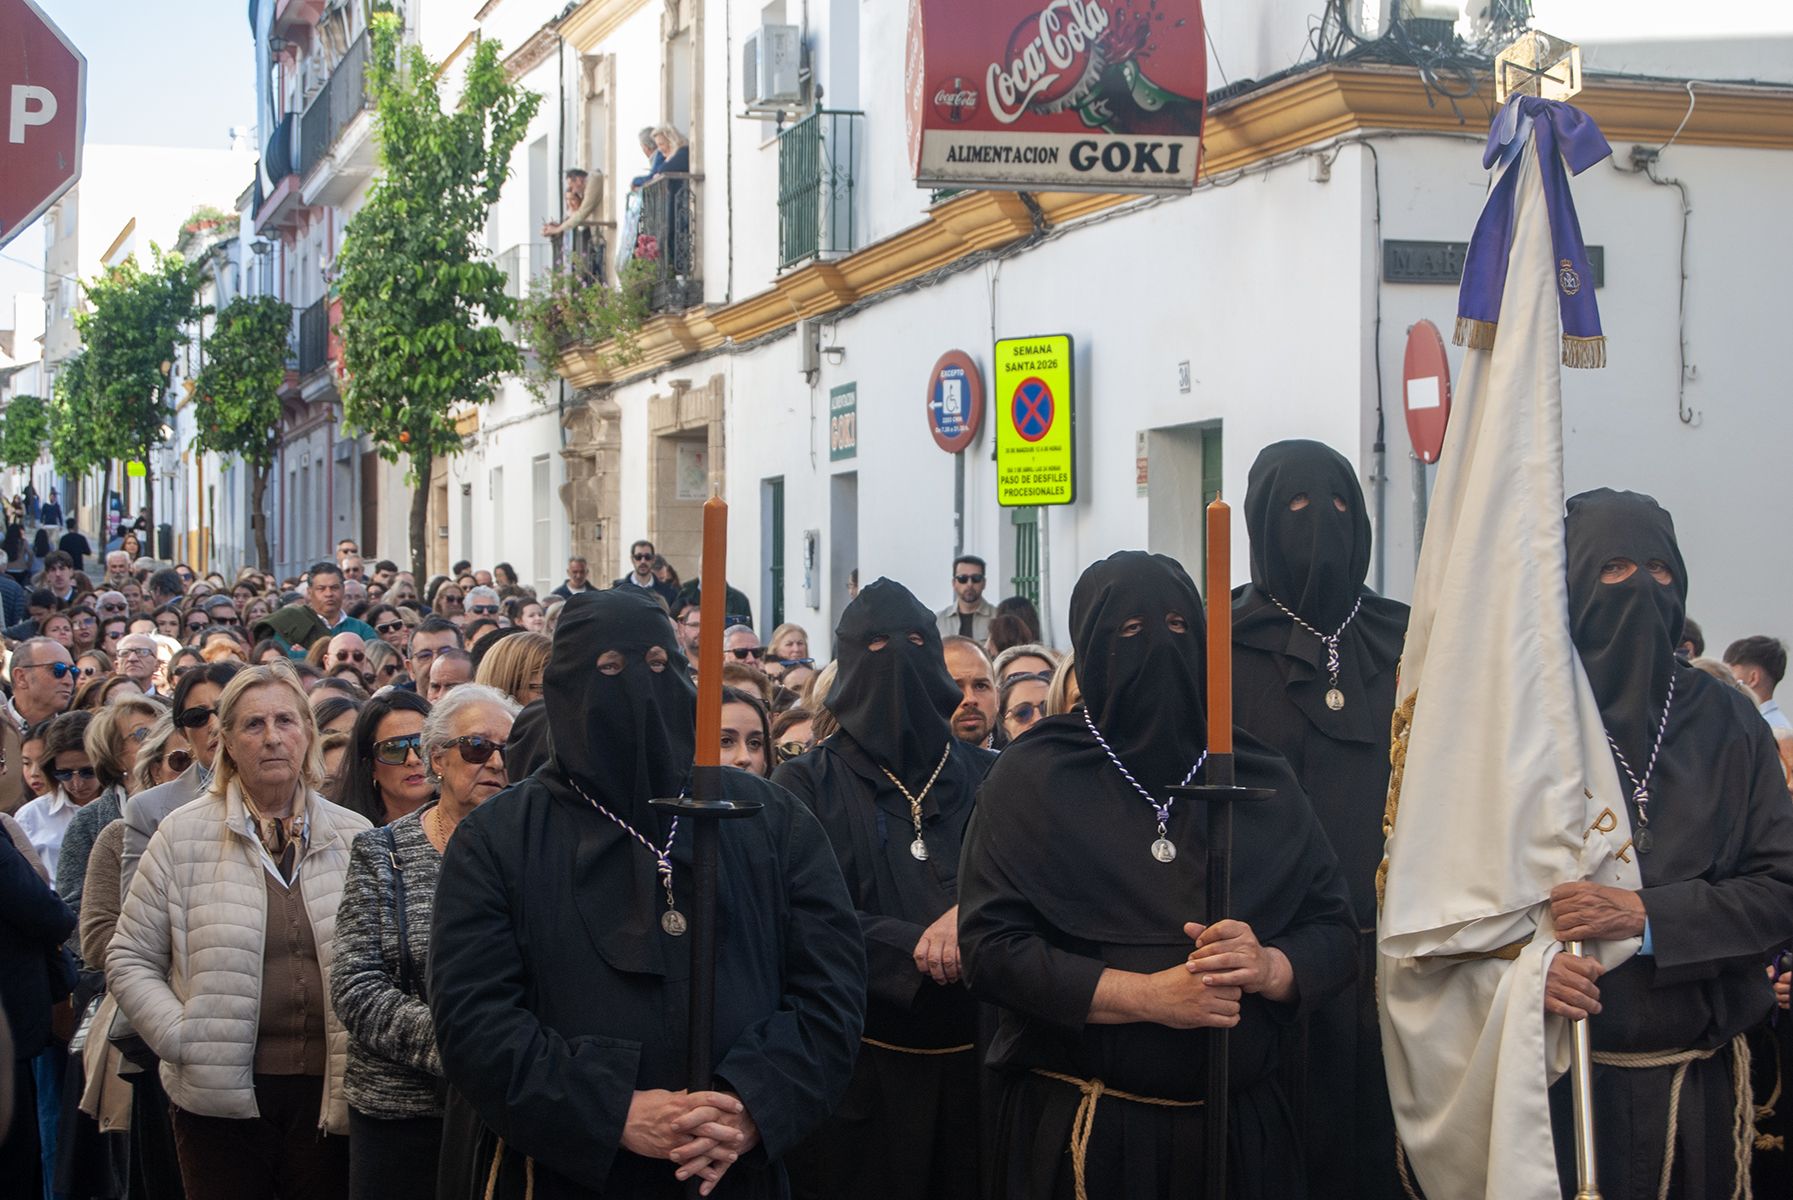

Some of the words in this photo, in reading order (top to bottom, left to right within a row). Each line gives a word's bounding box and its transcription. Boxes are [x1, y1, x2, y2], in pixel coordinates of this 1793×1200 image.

[946, 145, 1060, 165] ALIMENTACION
[1069, 140, 1184, 174] GOKI
[1013, 344, 1053, 357] SEMANA
[1005, 361, 1036, 373] SANTA
[1036, 359, 1058, 370] 2026
[940, 368, 965, 378] EXCEPTO
[1001, 474, 1019, 485] PASO
[1021, 474, 1031, 484] DE
[1033, 472, 1068, 484] DESFILES
[1004, 485, 1065, 497] PROCESIONALES
